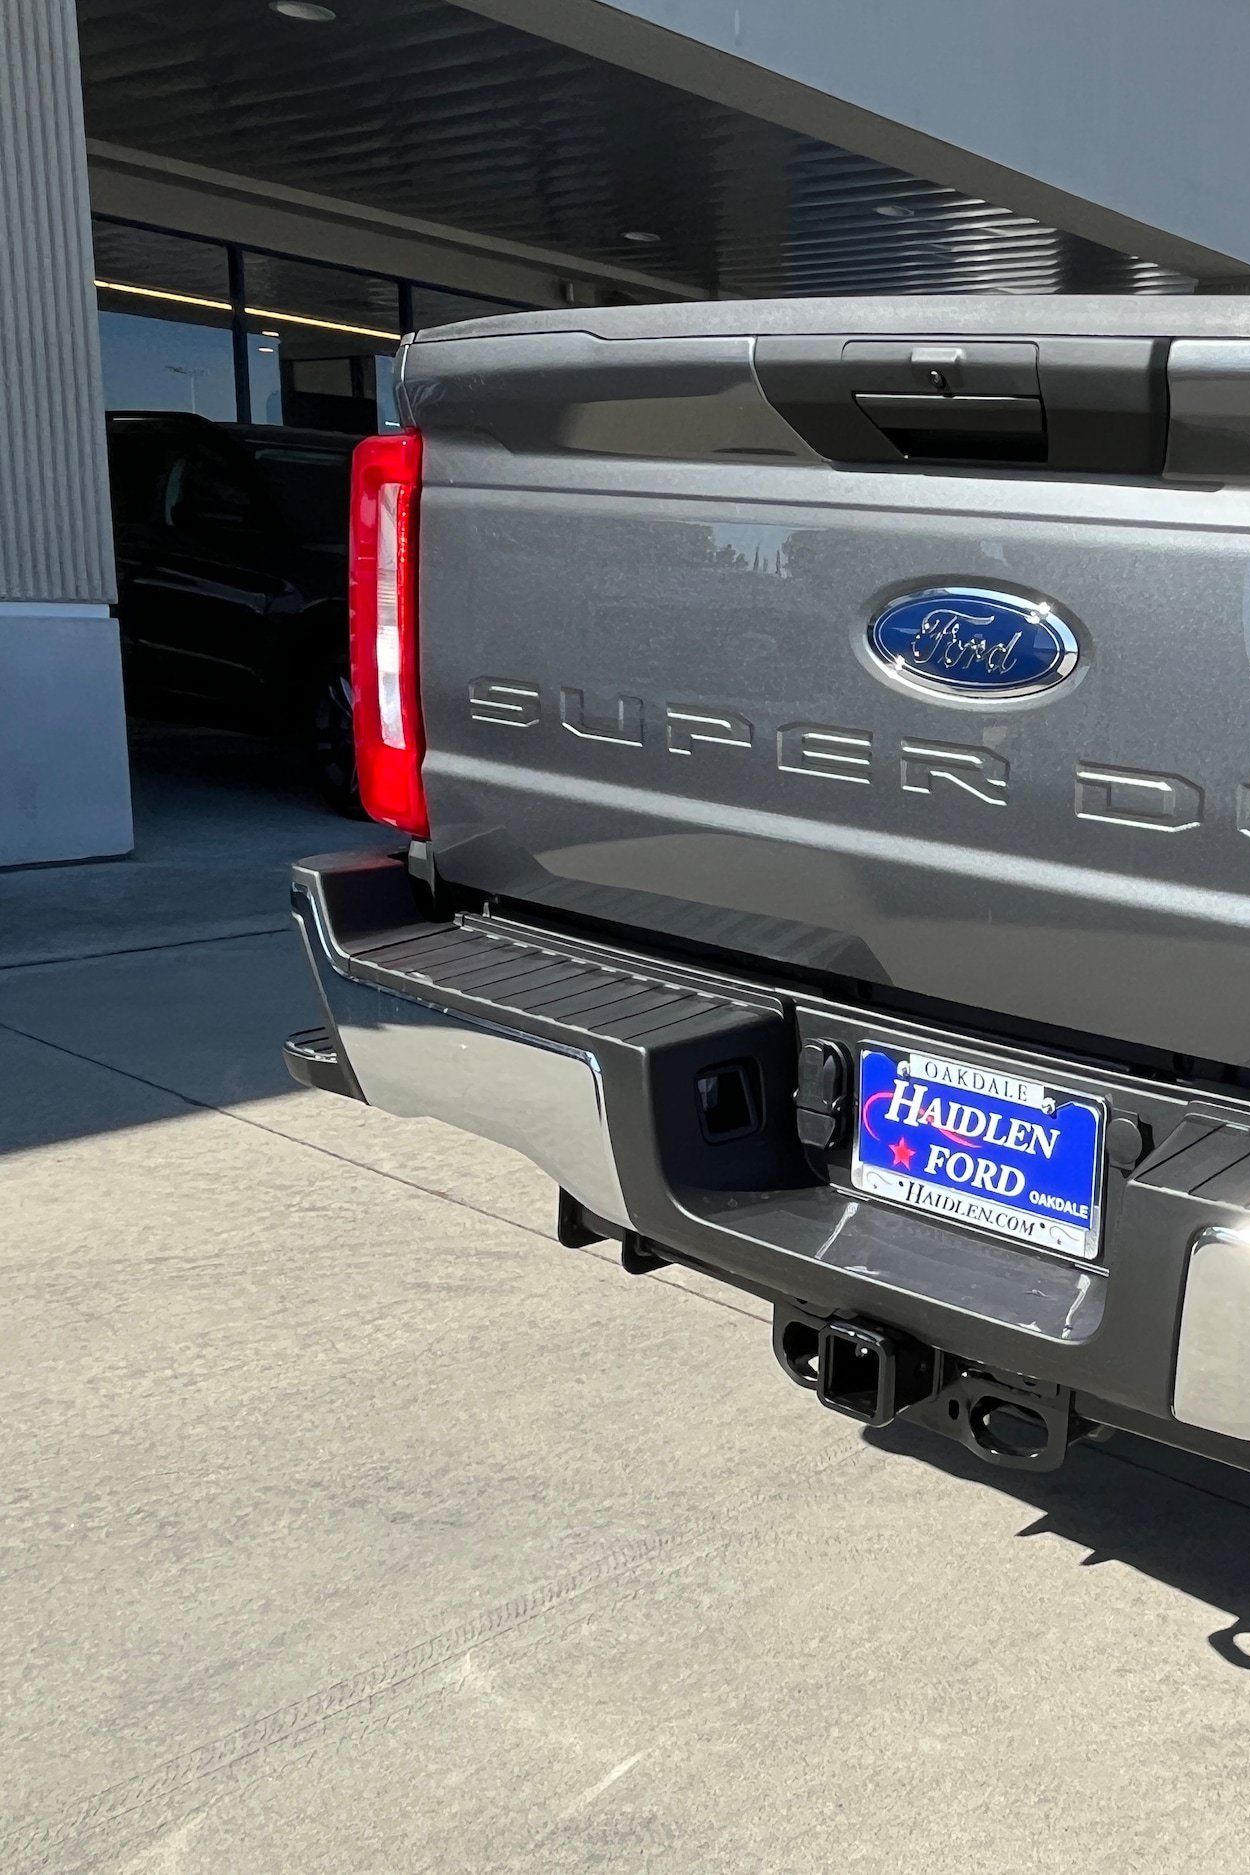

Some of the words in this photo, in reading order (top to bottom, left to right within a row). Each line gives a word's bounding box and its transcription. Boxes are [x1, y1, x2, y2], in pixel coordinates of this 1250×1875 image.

[910, 608, 1022, 674] Ford
[468, 675, 1010, 806] SUPER
[925, 1061, 1028, 1101] OAKDALE
[884, 1079, 1060, 1158] HAIDLEN
[924, 1144, 1026, 1197] FORD
[905, 1181, 1035, 1235] HAIDLEN.COM
[1028, 1190, 1089, 1219] OAKDALE
